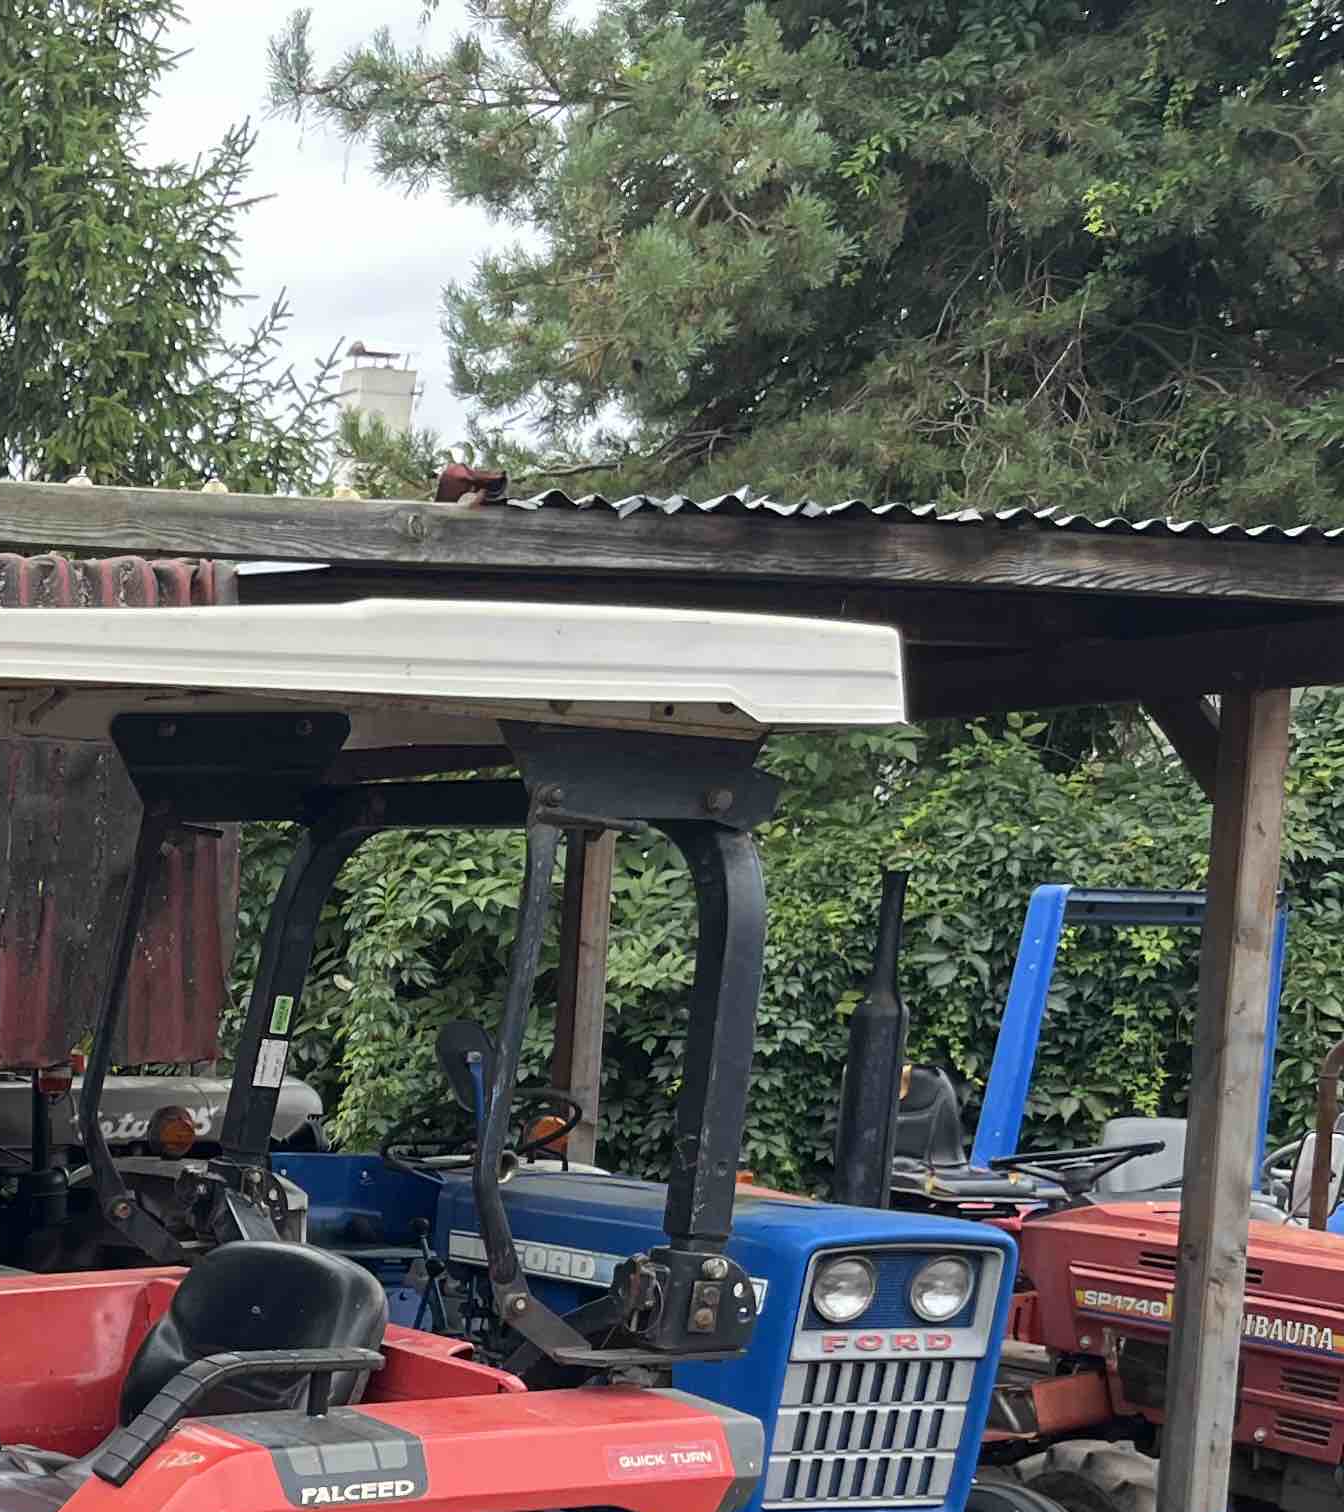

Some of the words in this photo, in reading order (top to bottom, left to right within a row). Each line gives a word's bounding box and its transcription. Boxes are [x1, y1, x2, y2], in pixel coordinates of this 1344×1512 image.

[514, 1246, 596, 1279] ORD
[1084, 1288, 1164, 1317] SP1740
[822, 1333, 953, 1354] FORD
[1242, 1312, 1333, 1351] IBAURA
[619, 1455, 665, 1469] QUICK
[671, 1451, 713, 1465] TURN
[301, 1480, 415, 1505] PALCEED
